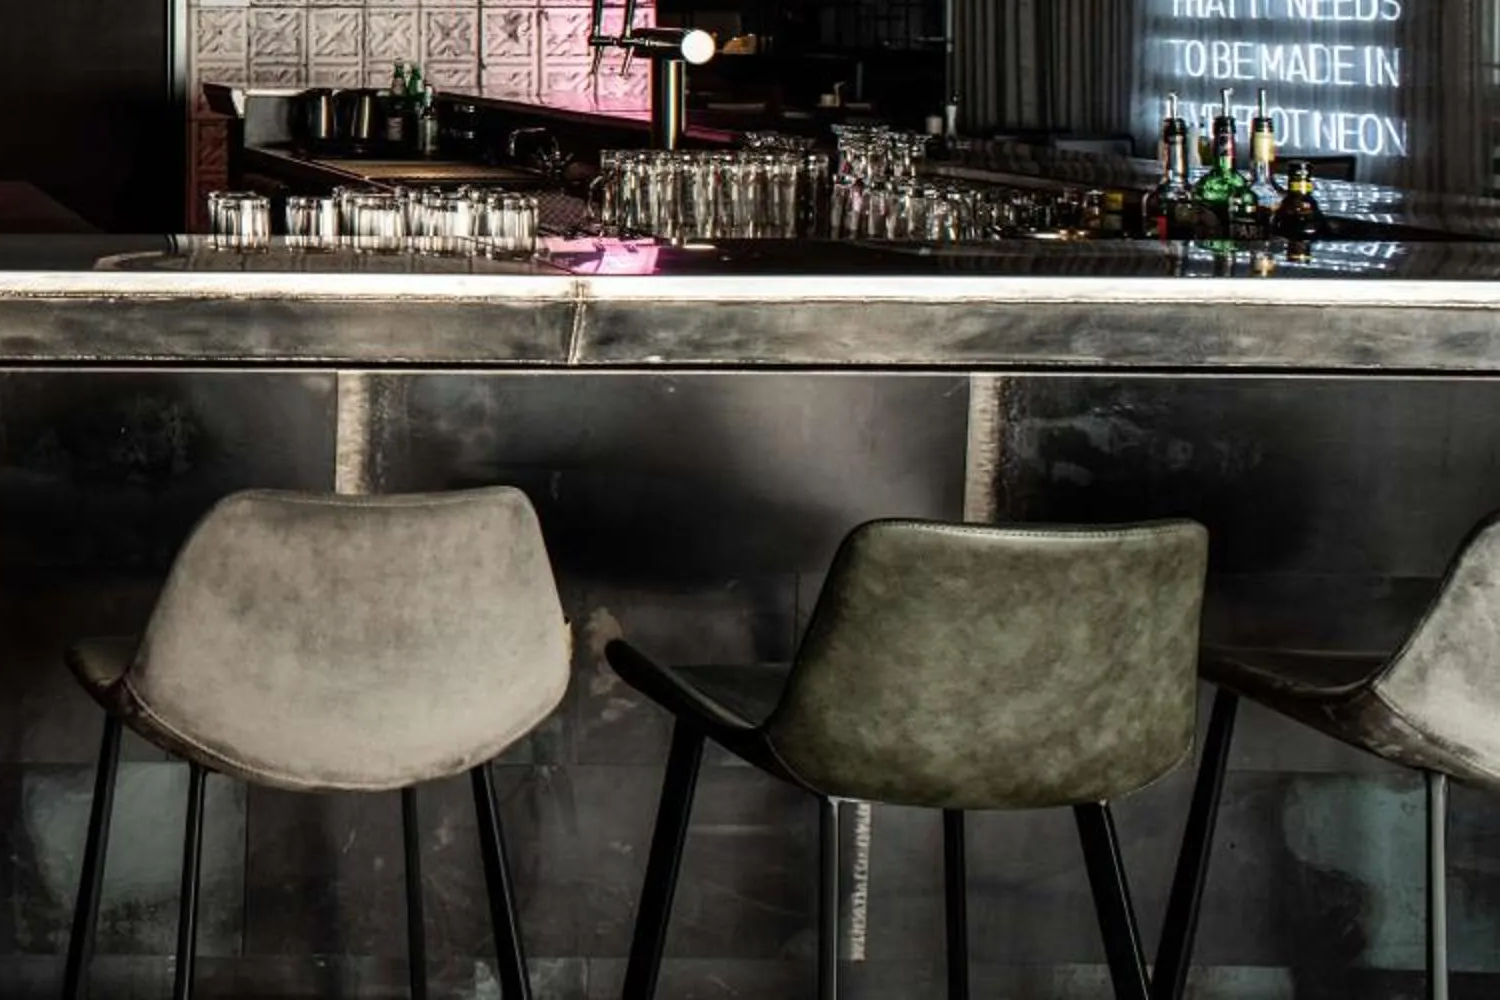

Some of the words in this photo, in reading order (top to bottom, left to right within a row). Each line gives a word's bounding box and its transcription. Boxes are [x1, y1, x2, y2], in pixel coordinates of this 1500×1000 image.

[1162, 38, 1206, 78] TO
[1212, 40, 1254, 80] BE
[1260, 43, 1357, 85] MADE
[1365, 46, 1401, 87] IN
[1314, 110, 1408, 157] NEON
